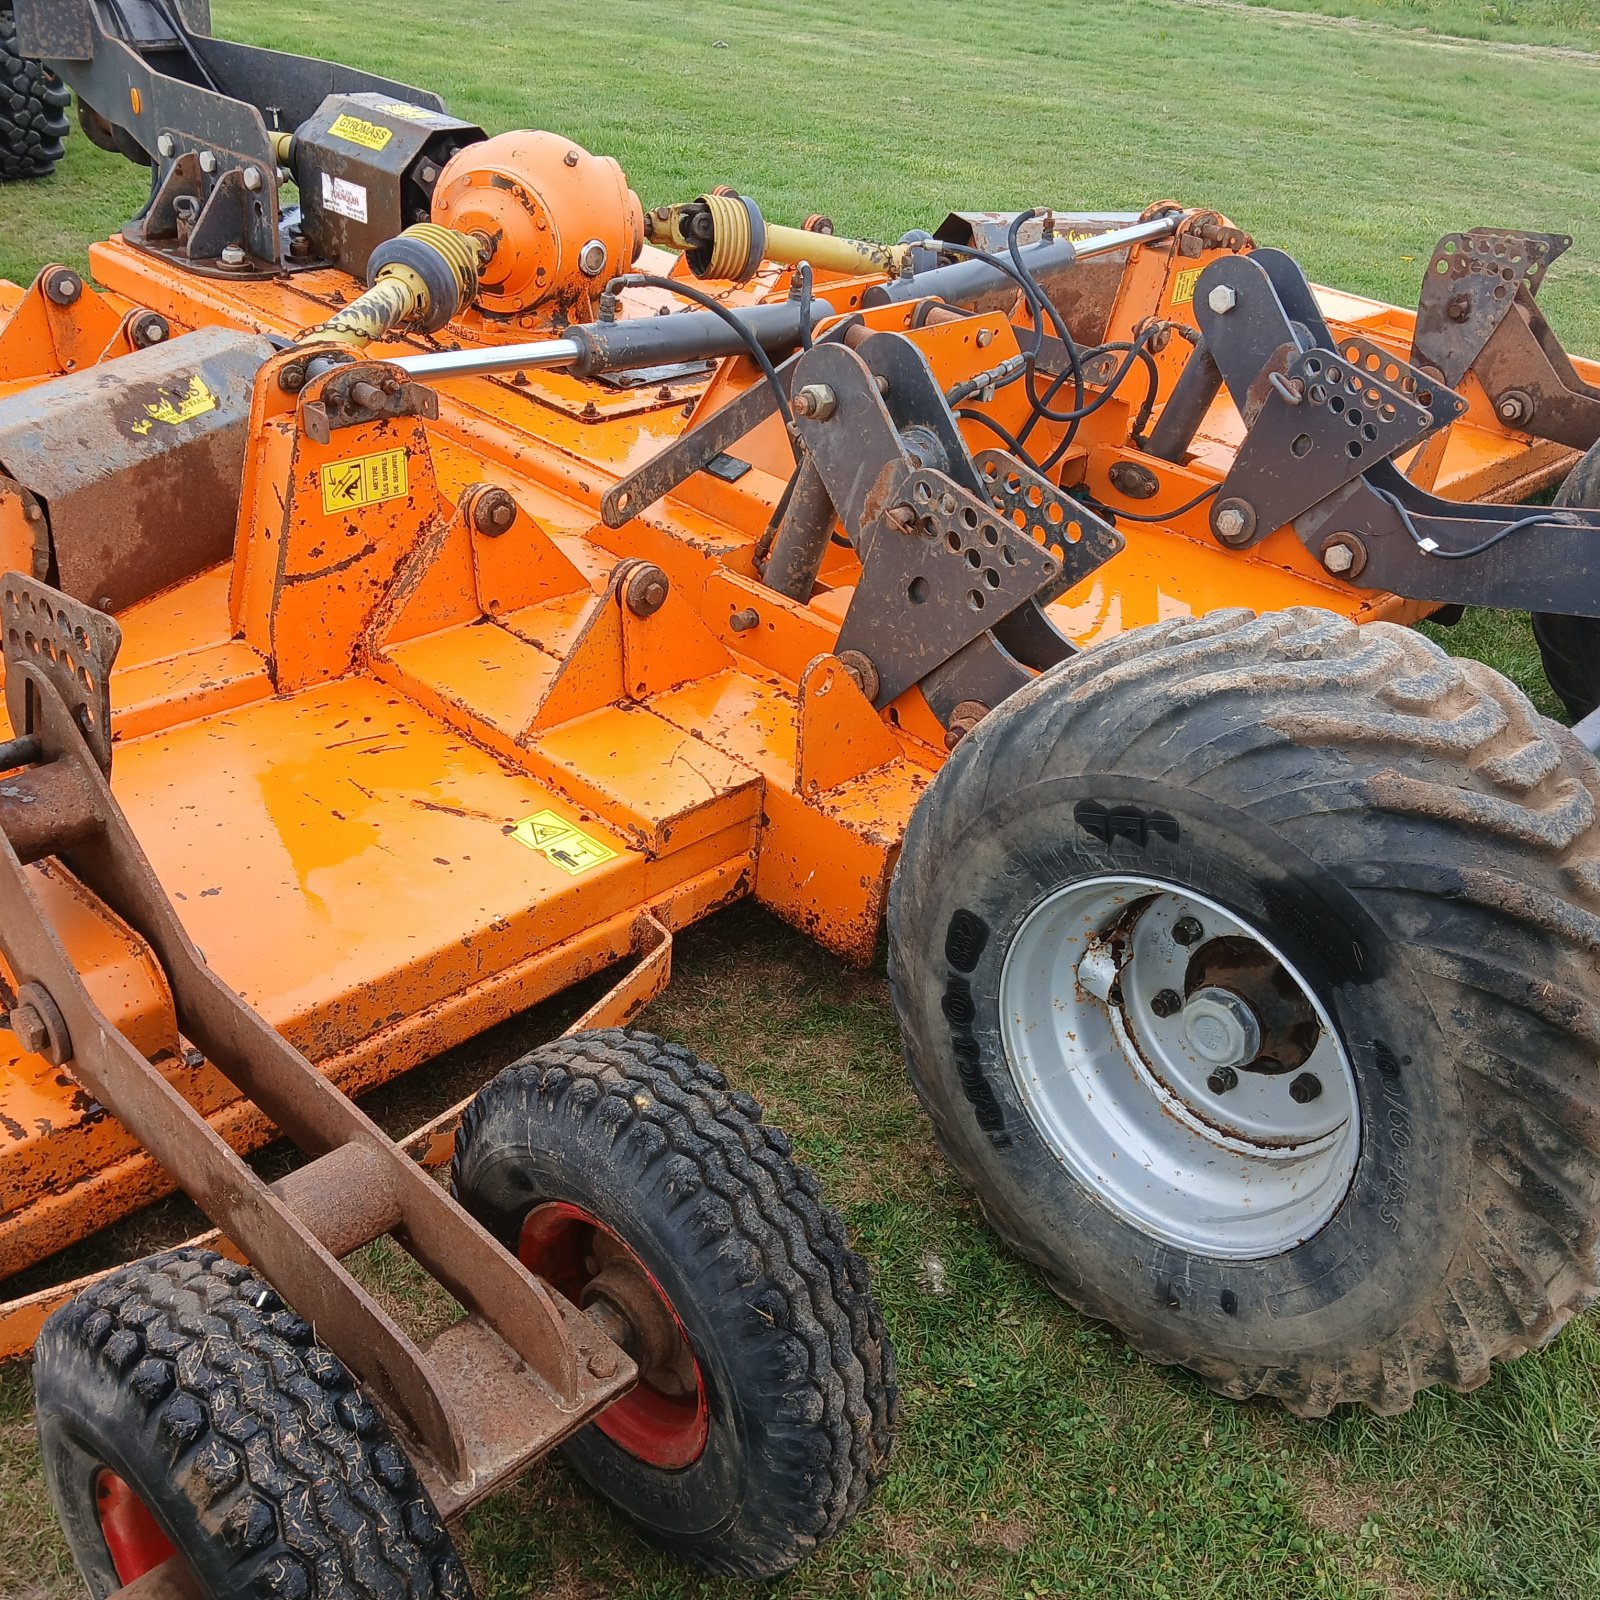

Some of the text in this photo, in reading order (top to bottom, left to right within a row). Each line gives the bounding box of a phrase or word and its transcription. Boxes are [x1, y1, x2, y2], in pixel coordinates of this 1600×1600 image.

[339, 117, 388, 140] GYROMASS
[371, 466, 379, 490] METTRE
[393, 484, 400, 494] DE
[945, 971, 1013, 1148] TRACTION
